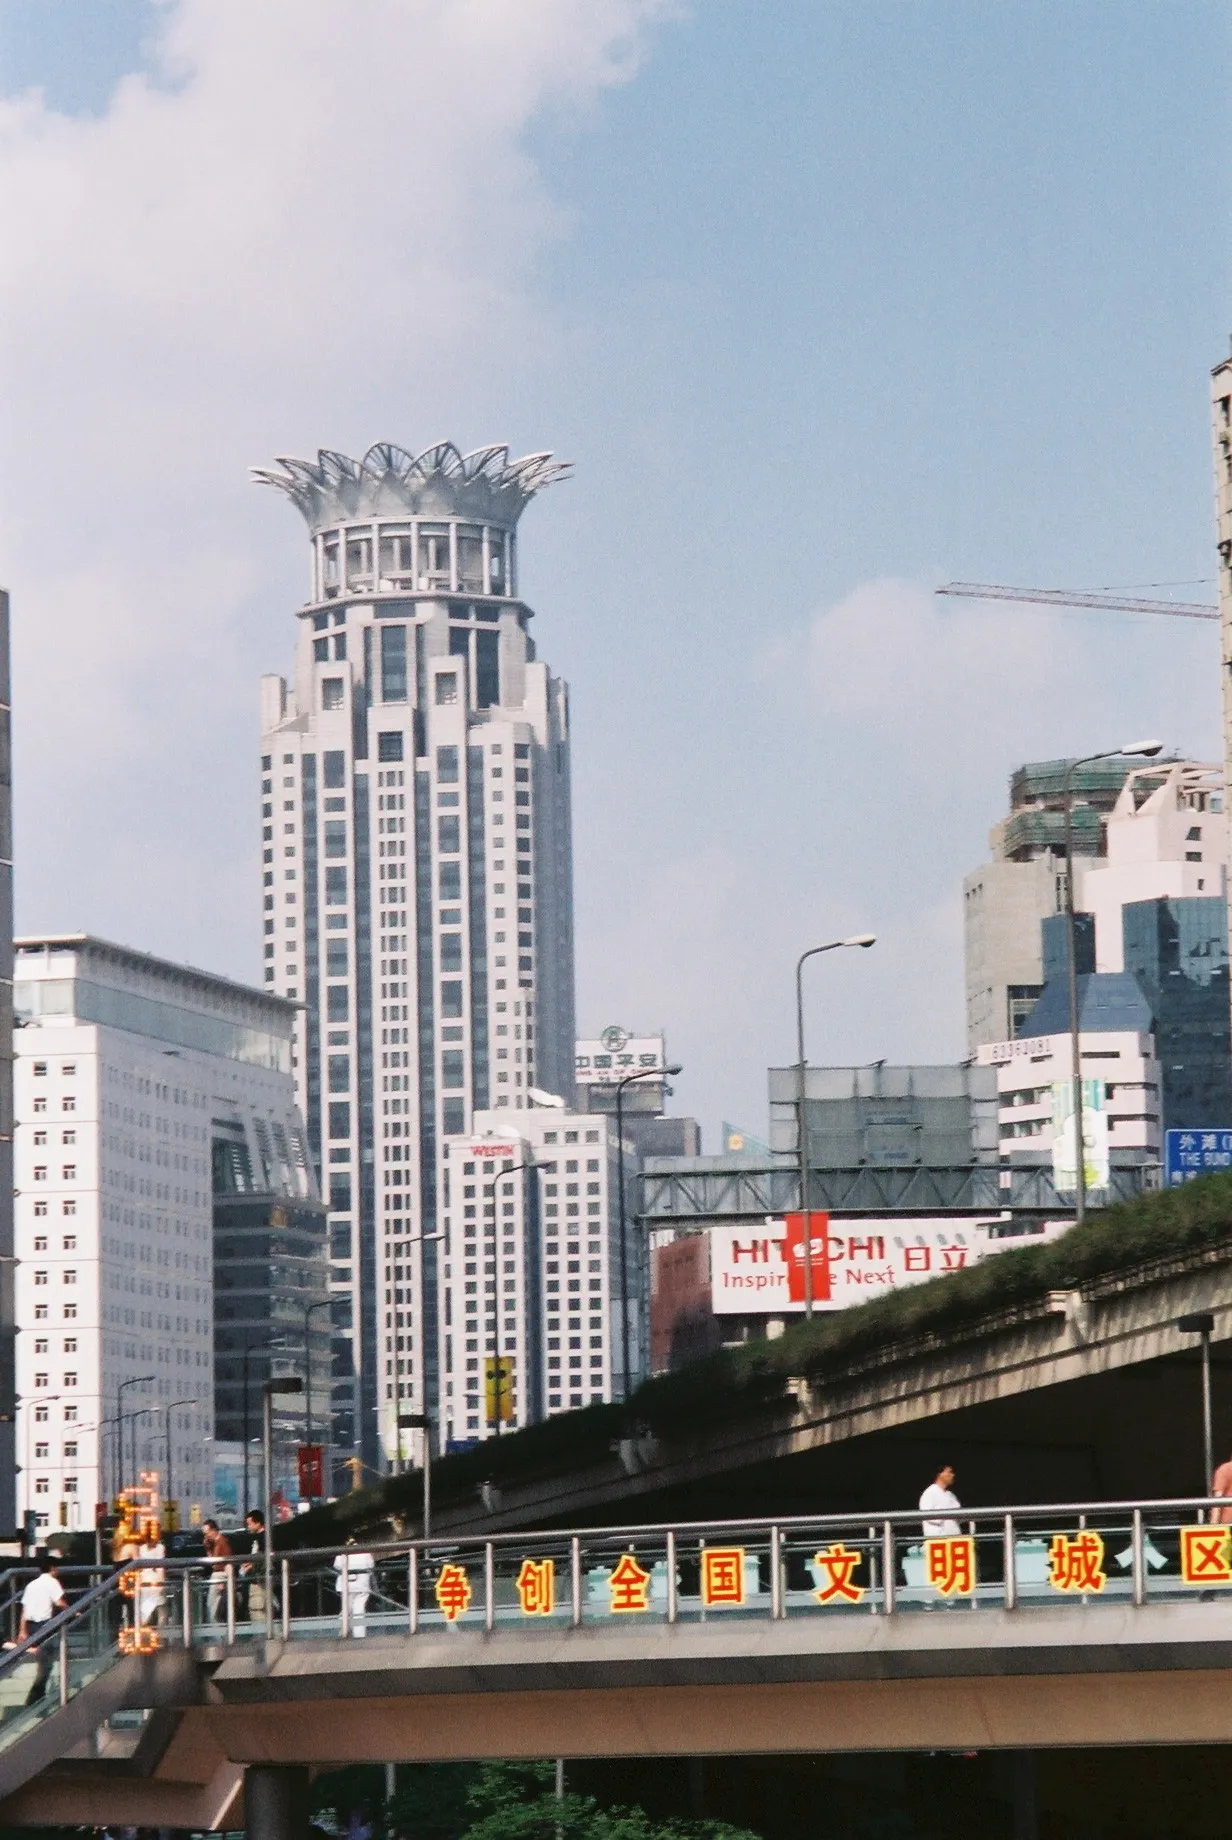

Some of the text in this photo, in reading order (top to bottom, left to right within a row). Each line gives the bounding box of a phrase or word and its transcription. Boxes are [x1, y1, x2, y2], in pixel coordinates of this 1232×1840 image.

[576, 1053, 657, 1068] 中国平安
[1180, 1152, 1200, 1166] THE
[732, 1236, 885, 1264] HITCHI
[905, 1246, 968, 1271] 日立
[723, 1271, 789, 1290] Inspir
[846, 1265, 895, 1285] Next
